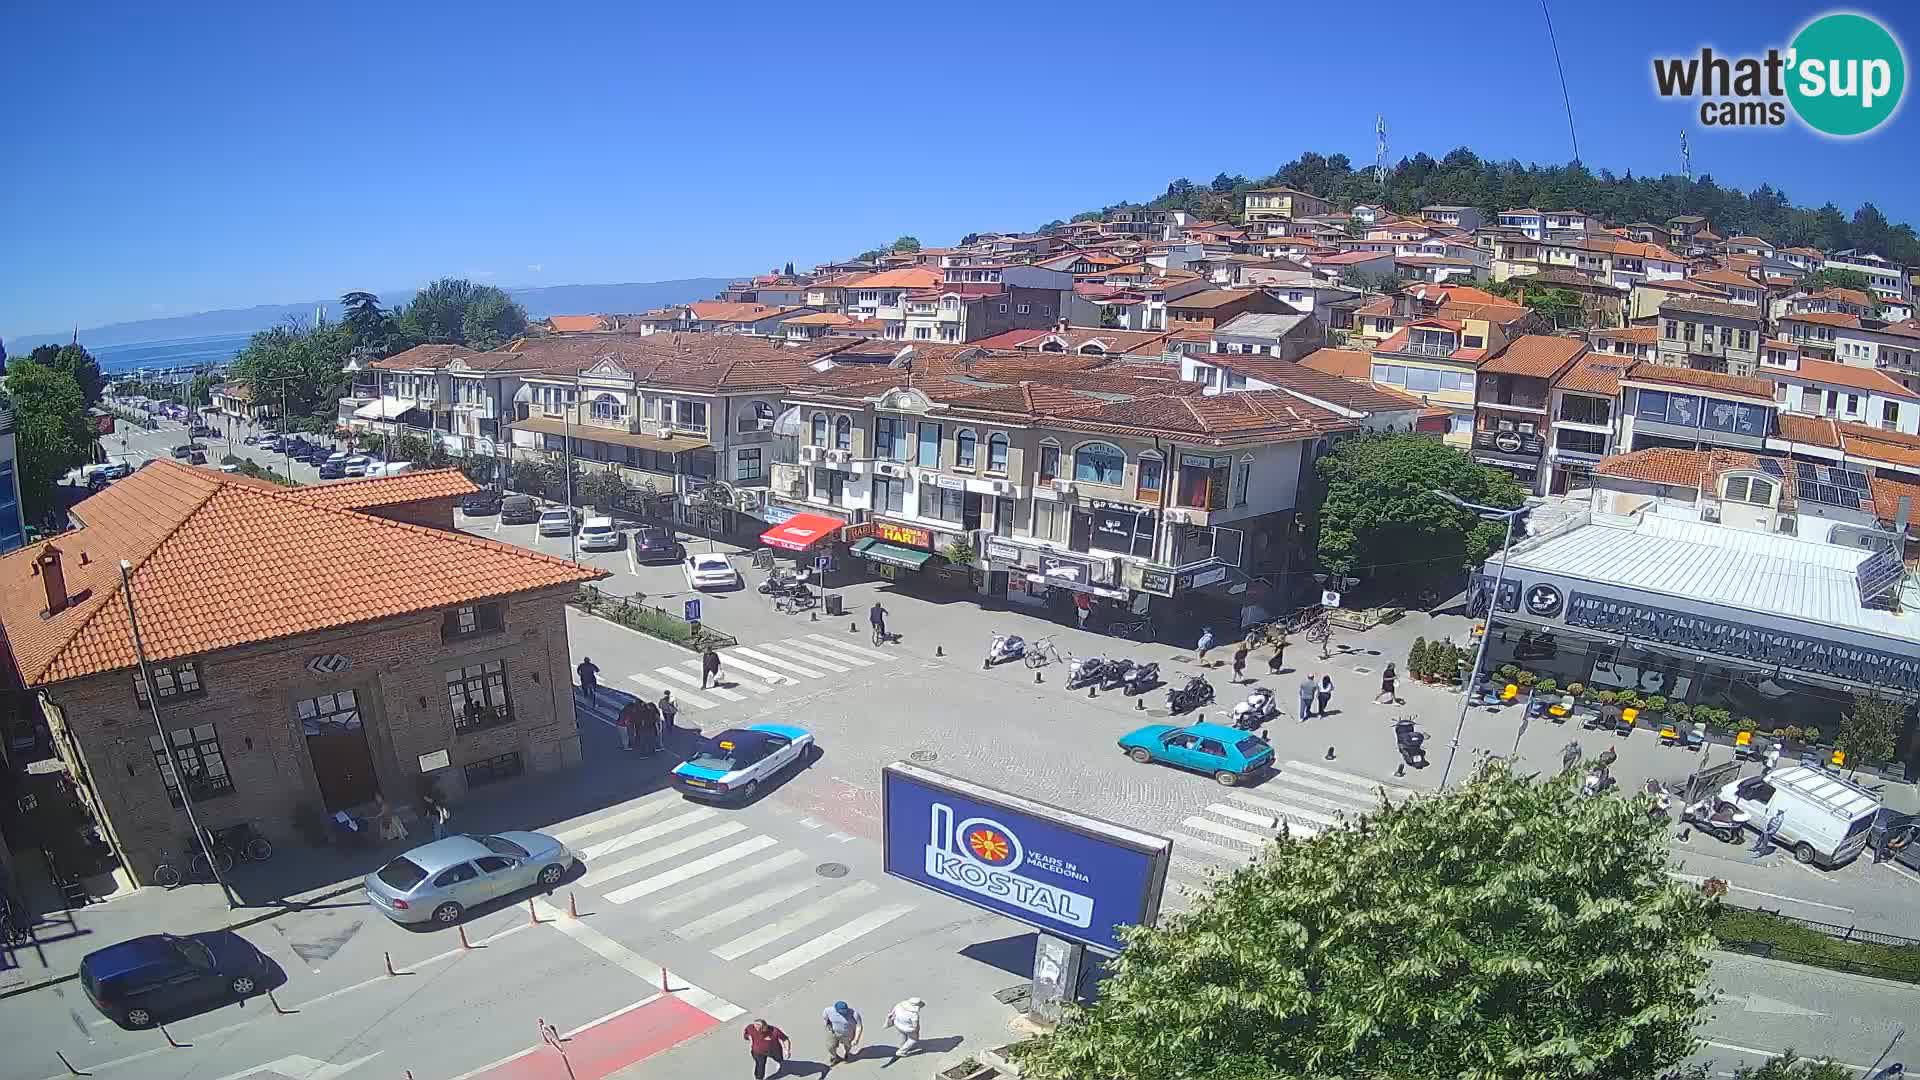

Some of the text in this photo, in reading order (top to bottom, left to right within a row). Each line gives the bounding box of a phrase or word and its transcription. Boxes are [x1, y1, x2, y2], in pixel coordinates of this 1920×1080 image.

[1026, 857, 1090, 883] MACEDONIA
[1028, 850, 1077, 871] YEARS IN
[935, 852, 1081, 921] KOSTAL
